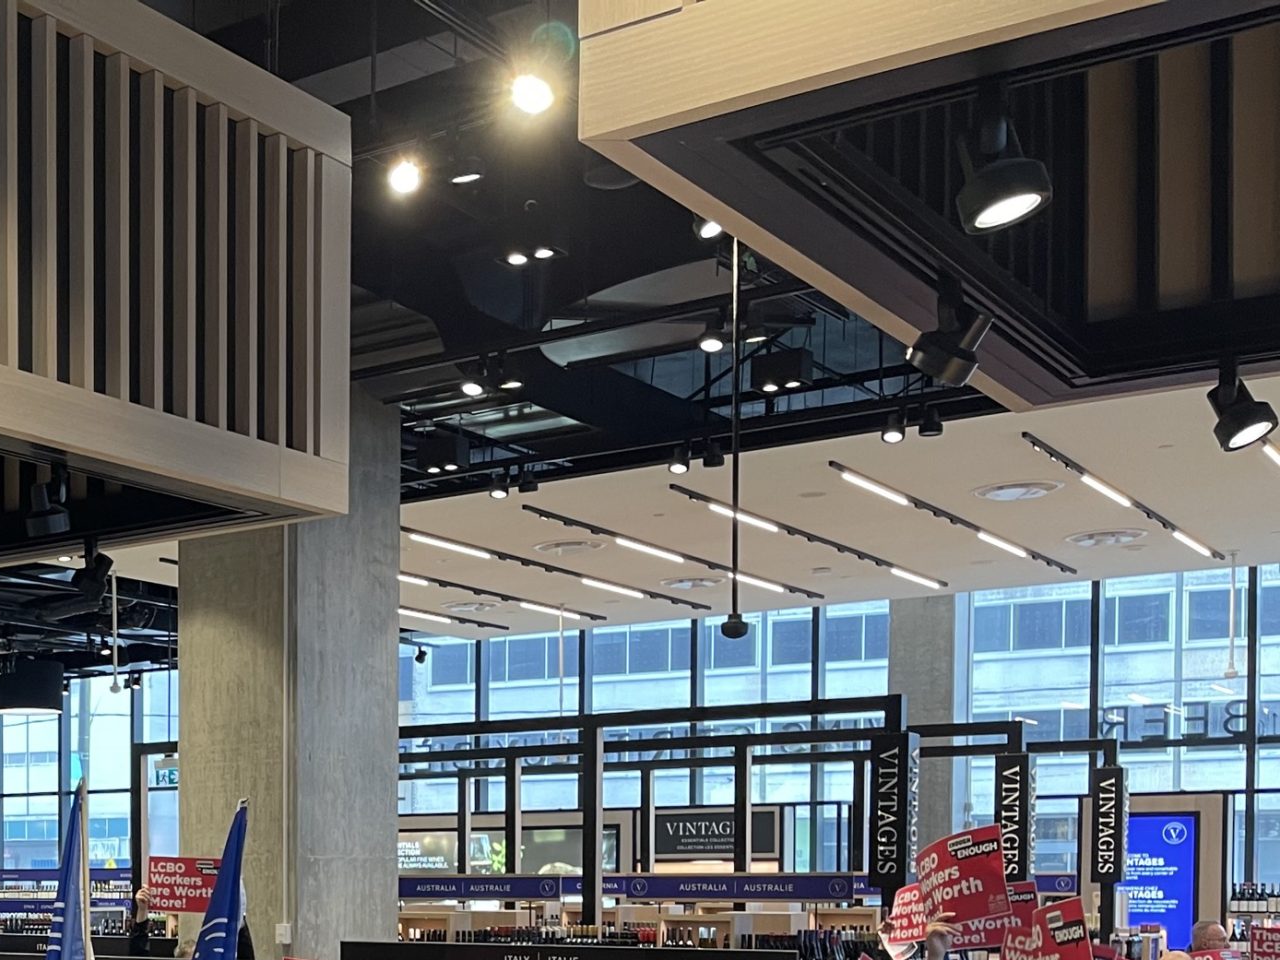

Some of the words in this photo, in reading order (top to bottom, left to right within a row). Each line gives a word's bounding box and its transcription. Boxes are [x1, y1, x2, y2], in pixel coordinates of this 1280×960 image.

[877, 746, 900, 874] VINTAGES
[1001, 765, 1020, 875] VINTAGES
[1097, 777, 1116, 874] VINTAGES
[956, 841, 998, 859] ENOUGH
[150, 861, 186, 874] LCBO
[150, 873, 203, 886] Workers
[150, 887, 171, 897] are
[416, 884, 457, 892] AUSTRALIA
[469, 884, 512, 893] AUSTRALIE
[679, 883, 728, 892] AUSTRALIA
[743, 883, 795, 893] AUSTRALIE
[932, 877, 984, 905] Worth
[150, 898, 186, 909] More!
[968, 916, 1022, 931] Worth
